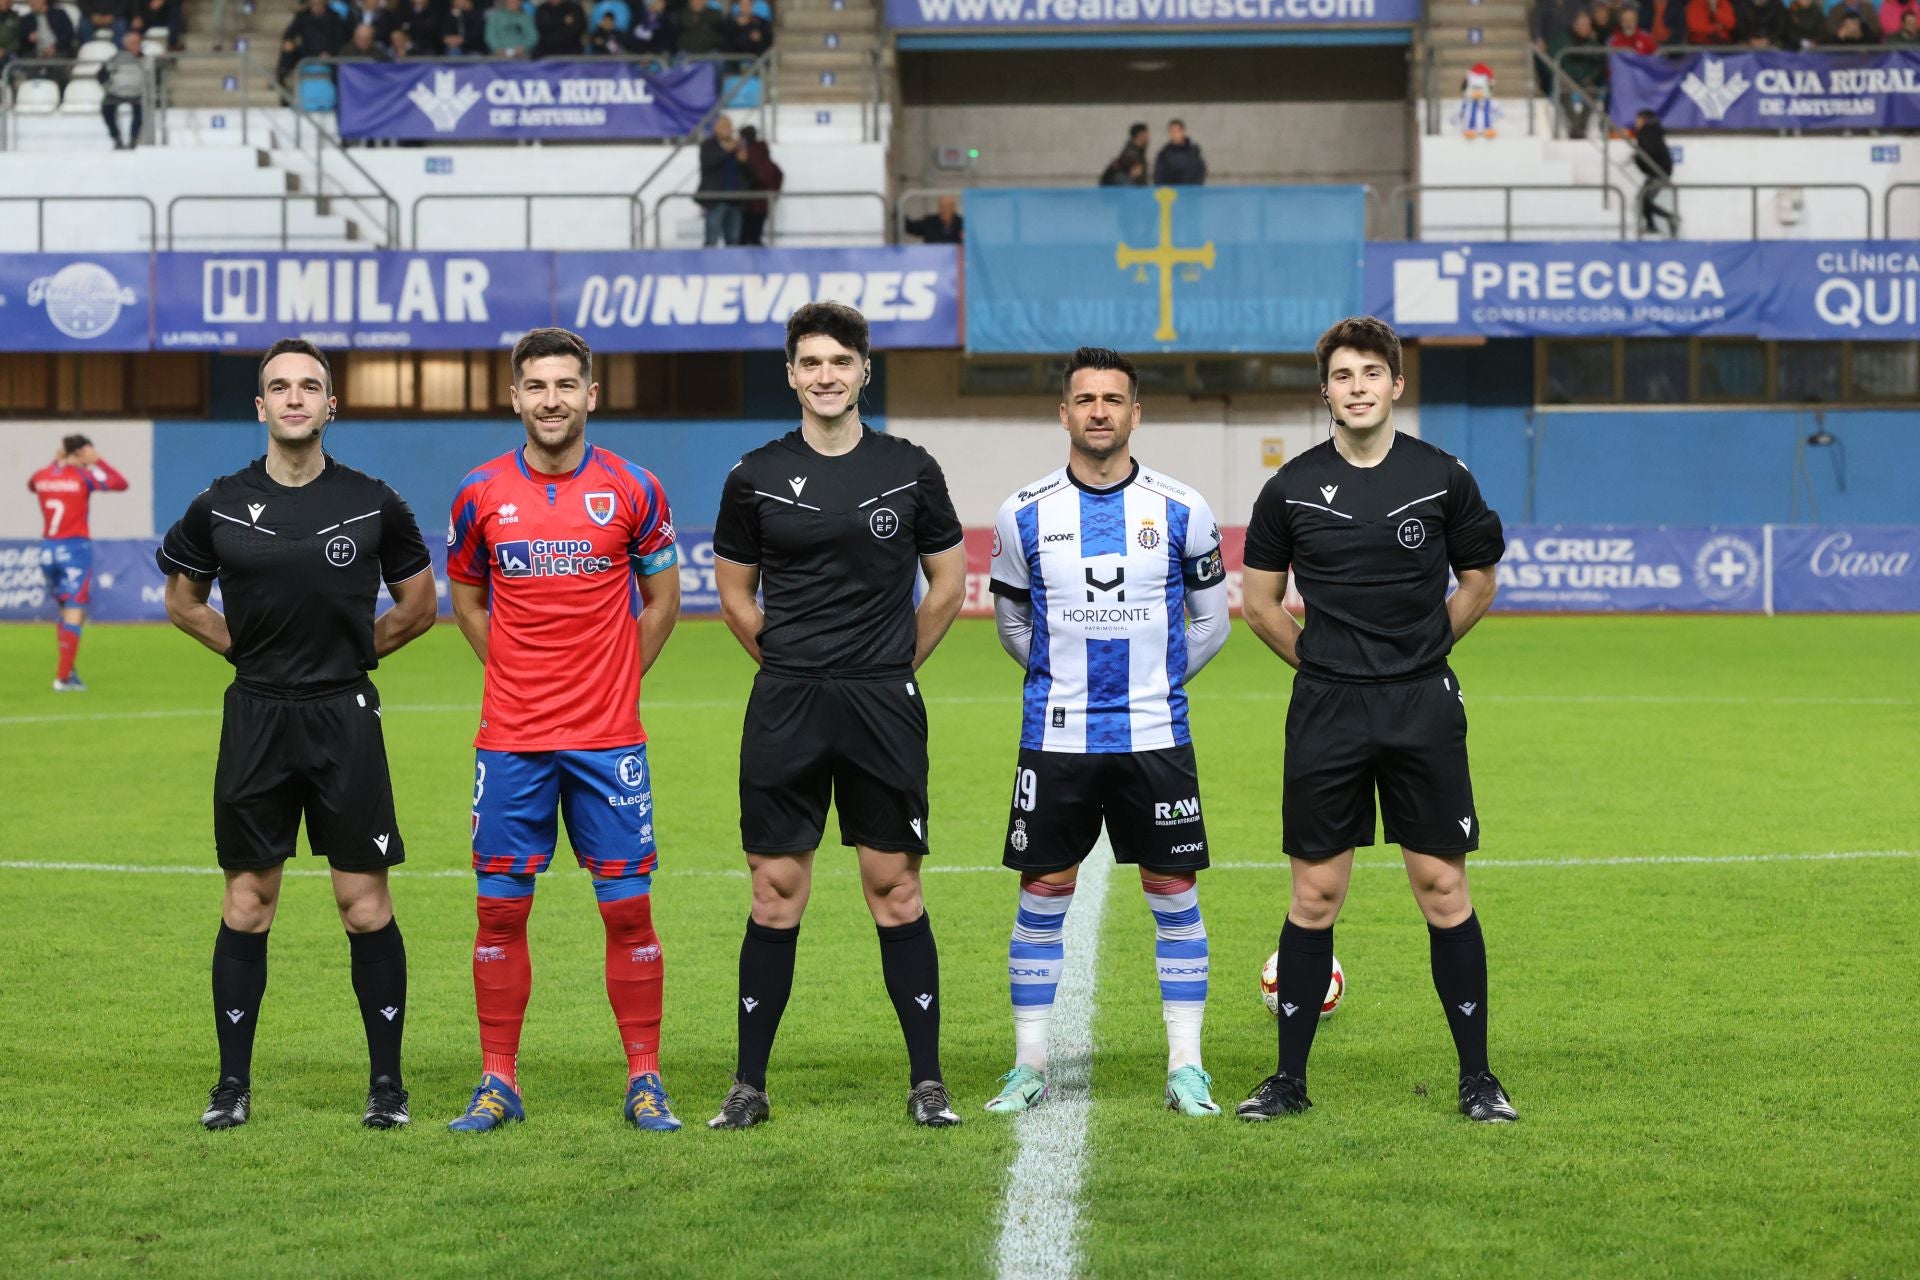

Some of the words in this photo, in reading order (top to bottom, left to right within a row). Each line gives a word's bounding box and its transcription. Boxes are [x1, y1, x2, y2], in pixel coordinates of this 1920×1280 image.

[485, 79, 556, 106] CAJA
[559, 78, 654, 105] RURAL
[1755, 69, 1824, 95] CAJA
[1829, 67, 1920, 93] RURAL
[489, 108, 515, 127] DE
[1758, 98, 1786, 116] DE
[1787, 98, 1876, 116] ASTURIAS
[1816, 248, 1920, 274] CLÍNICA
[276, 259, 490, 323] MILAR
[1472, 261, 1726, 300] PRECUSA
[650, 270, 938, 326] NEVARES
[45, 499, 66, 537] 7
[531, 539, 592, 556] Grupo
[1534, 538, 1635, 562] CRUZ
[1810, 531, 1911, 577] Casa
[532, 554, 613, 577] Herce
[1498, 564, 1683, 588] ASTURIAS
[1062, 608, 1151, 623] HORIZONTE
[1013, 766, 1037, 812] 19
[1154, 796, 1200, 820] RAW
